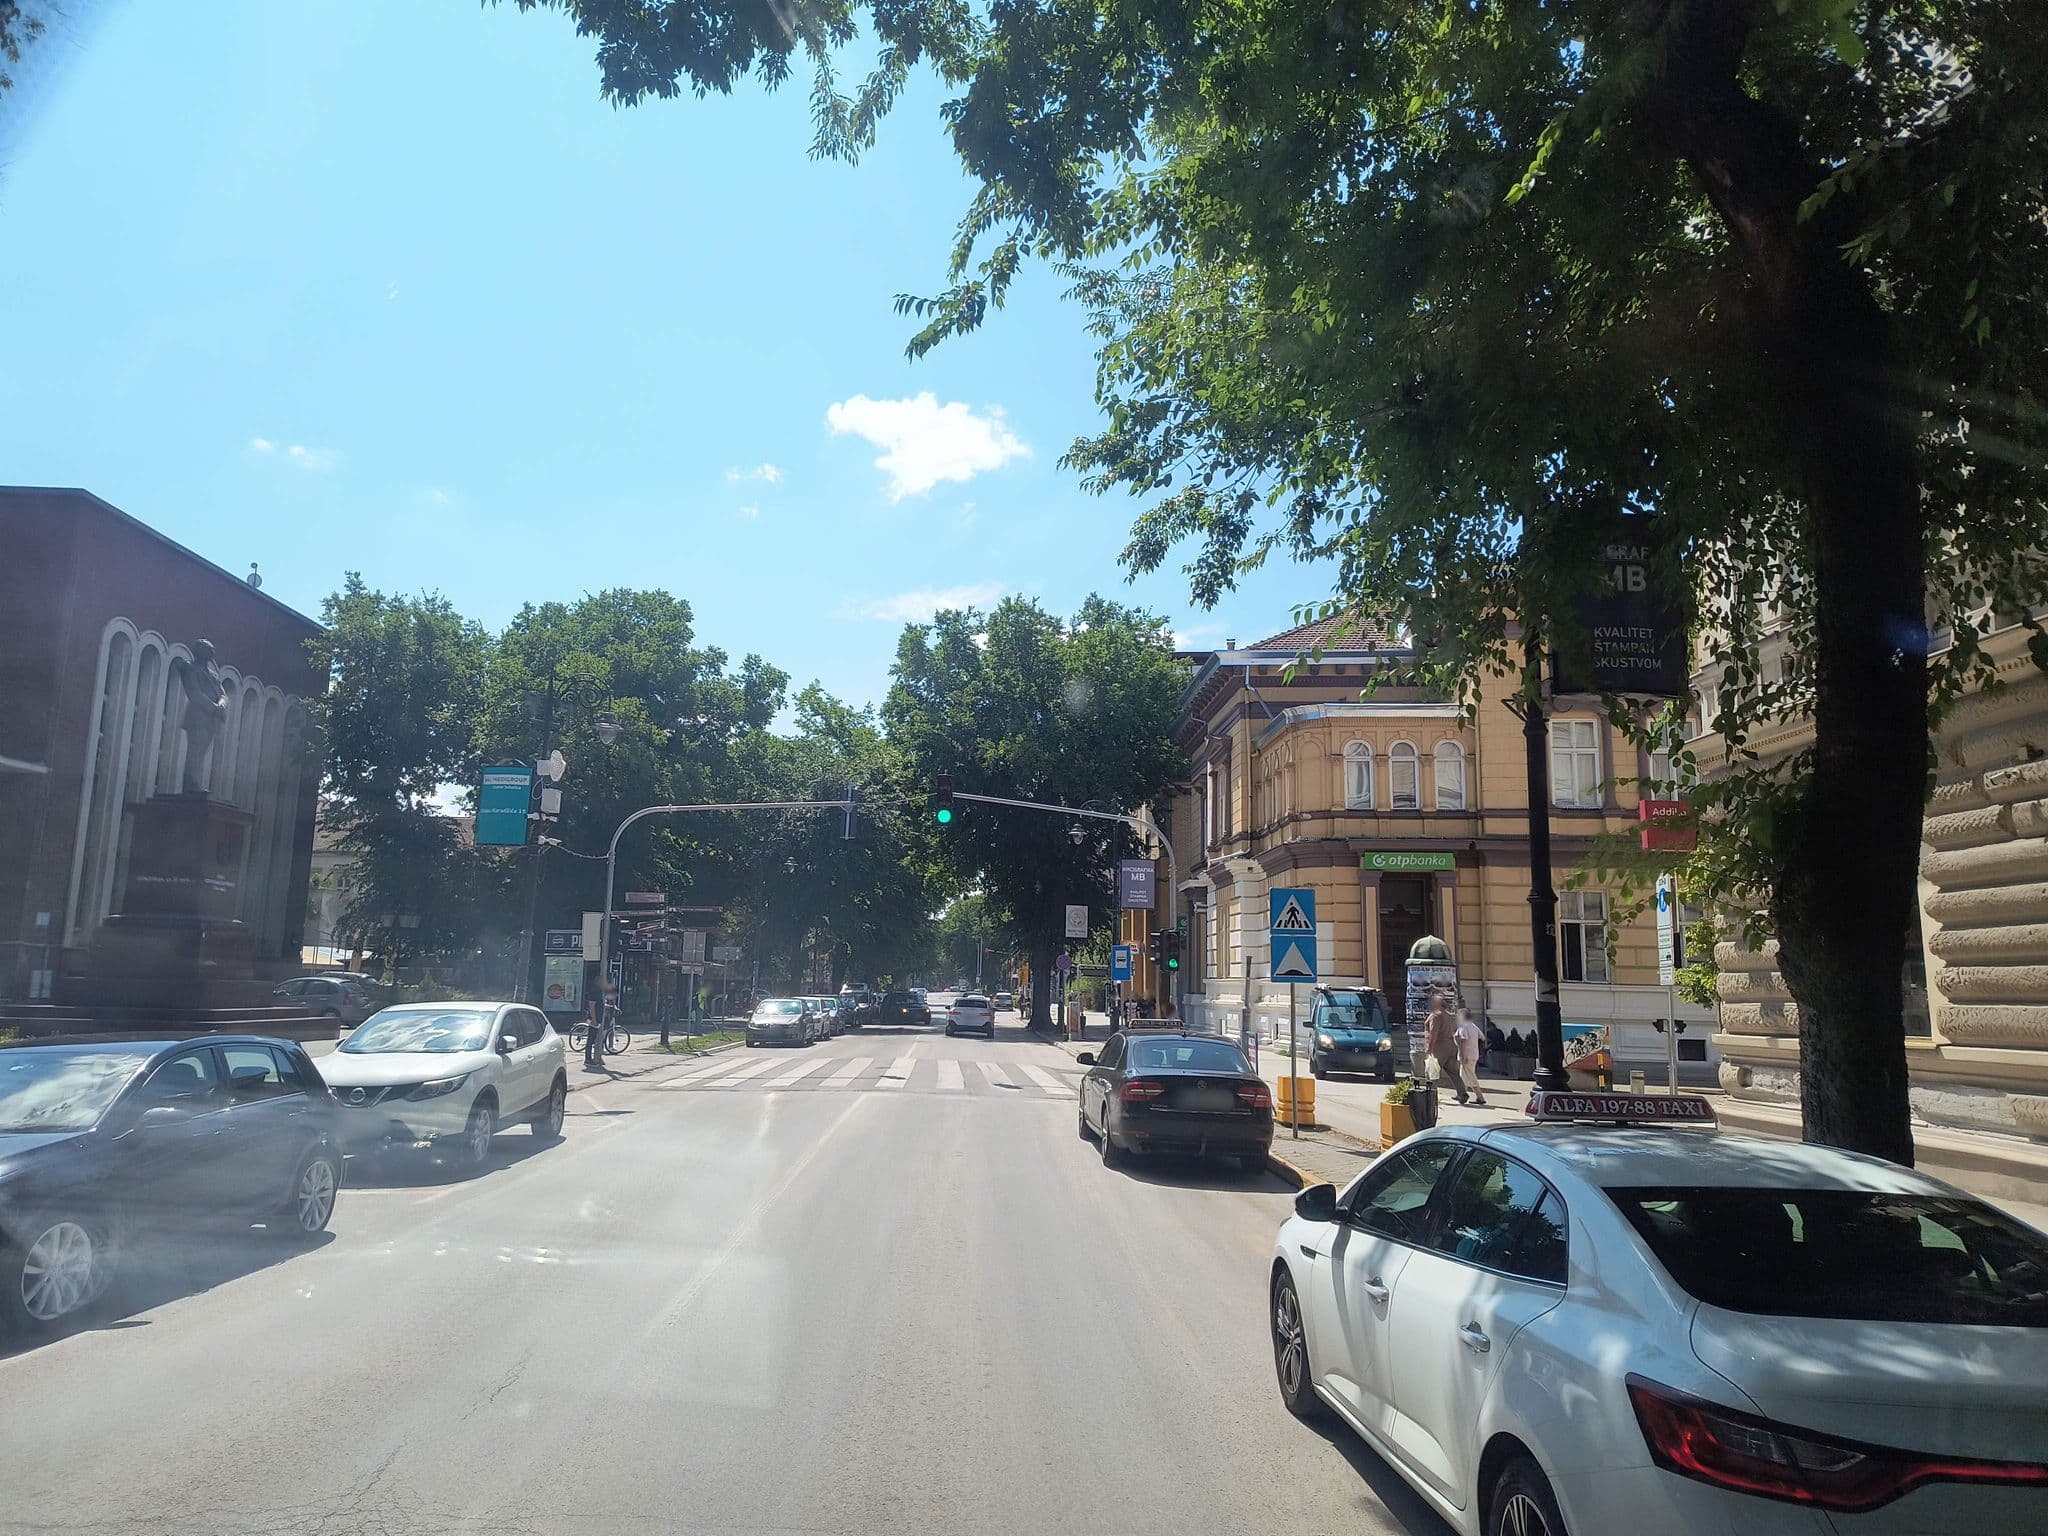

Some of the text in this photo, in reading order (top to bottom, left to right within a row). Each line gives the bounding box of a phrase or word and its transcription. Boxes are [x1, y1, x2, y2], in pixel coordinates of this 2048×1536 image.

[1594, 626, 1654, 639] KVALITET
[1594, 656, 1662, 669] SKUSTVOM
[1388, 854, 1446, 868] otpbanka
[1131, 872, 1146, 881] MB
[1549, 1098, 1597, 1113] ALFA
[1600, 1100, 1656, 1114] 197-88
[1658, 1101, 1707, 1116] TAXI
